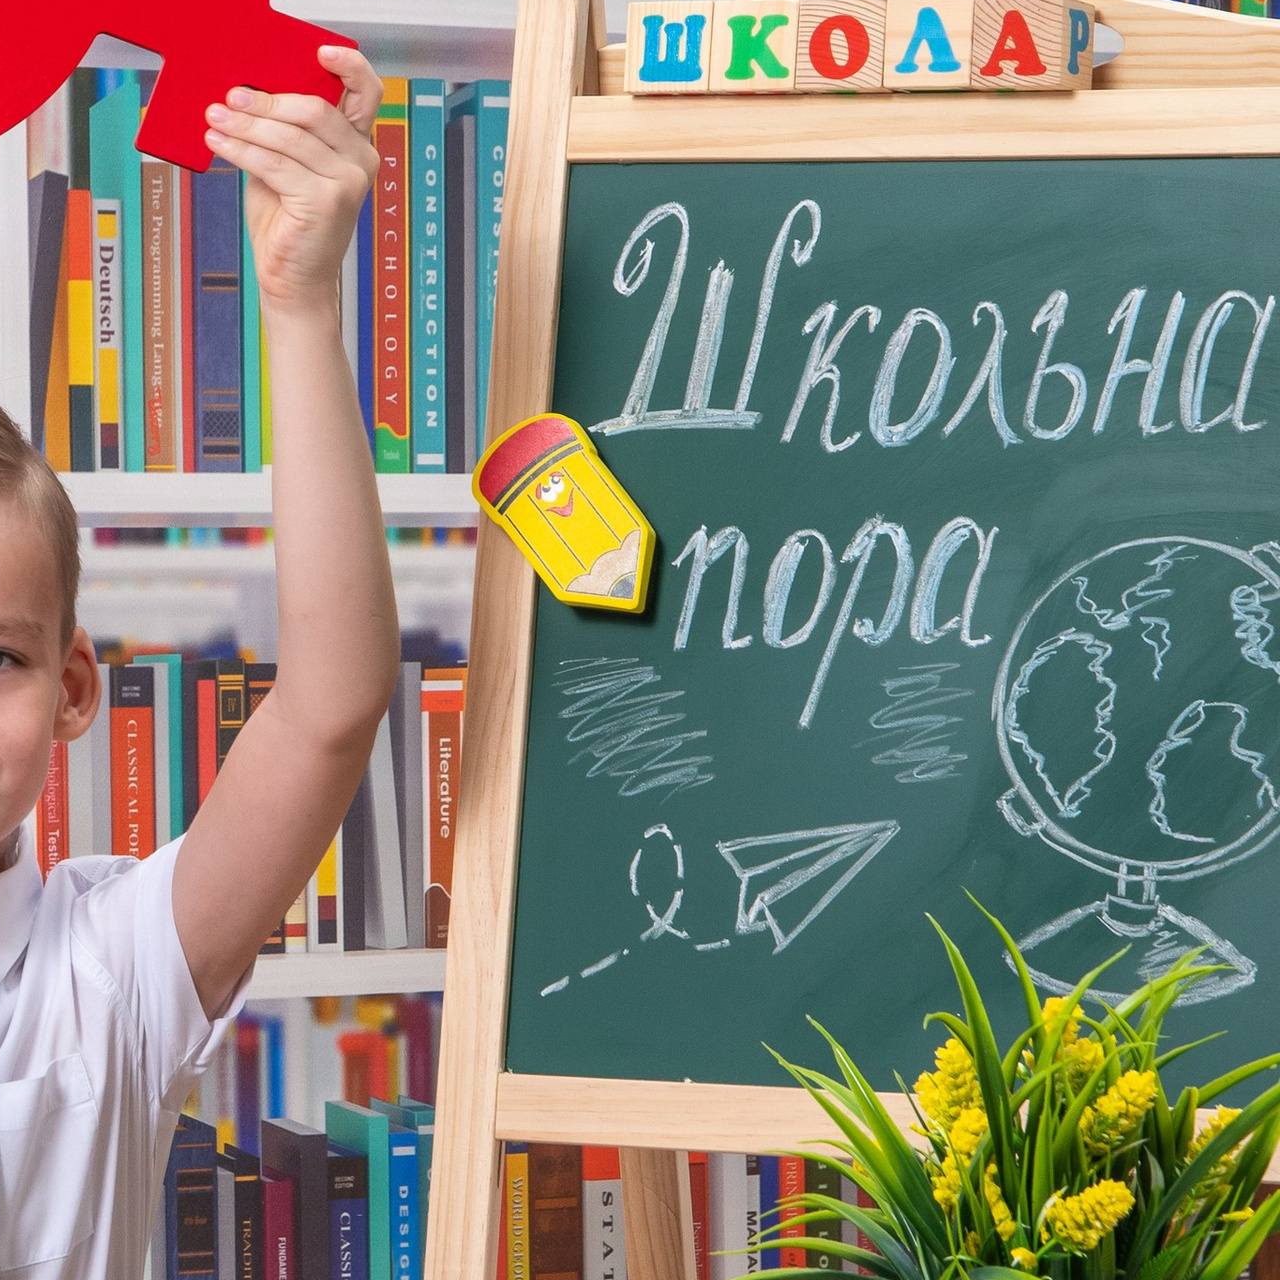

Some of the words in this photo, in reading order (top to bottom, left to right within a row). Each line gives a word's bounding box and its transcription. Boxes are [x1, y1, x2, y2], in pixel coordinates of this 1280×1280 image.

[152, 175, 163, 210] The
[99, 245, 115, 343] Deutsch
[151, 215, 163, 338] Programming
[384, 156, 397, 405] PSYCHOLOGY
[424, 144, 437, 427] CONSTRUCTION
[672, 513, 999, 730] пора
[127, 719, 139, 819] CLASSICAL
[439, 737, 452, 839] Literature
[512, 1177, 524, 1237] WORLD
